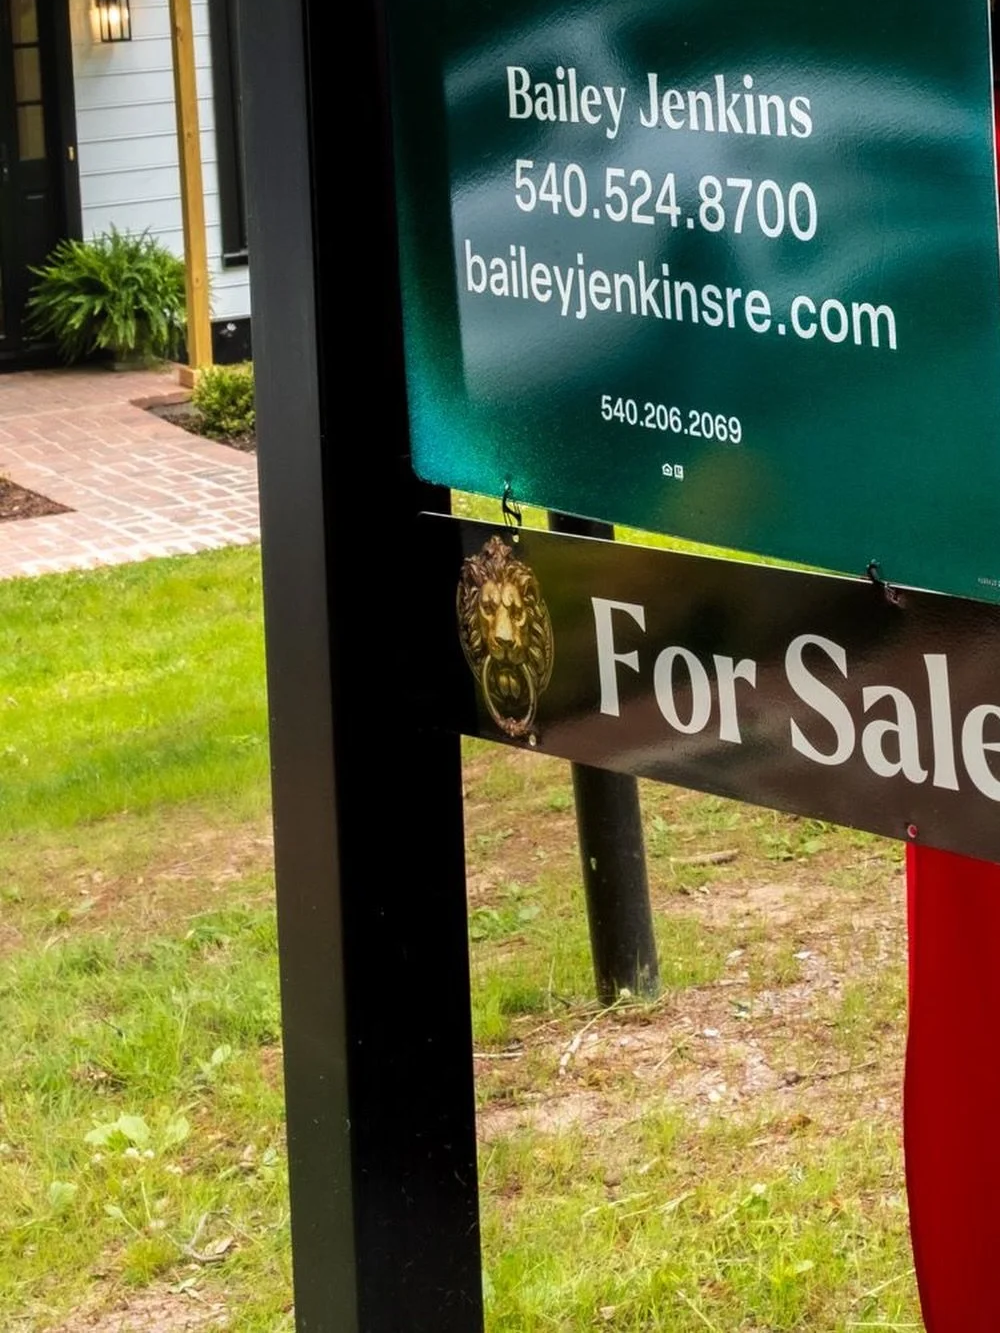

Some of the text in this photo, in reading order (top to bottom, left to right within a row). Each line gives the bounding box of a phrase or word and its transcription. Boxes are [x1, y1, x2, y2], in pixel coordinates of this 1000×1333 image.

[506, 65, 813, 138] Bailey Jenkins
[514, 159, 818, 241] 540.524.8700
[464, 240, 897, 349] baileyjenkinsre.com
[601, 394, 742, 444] 540.206.2069
[591, 597, 757, 744] For
